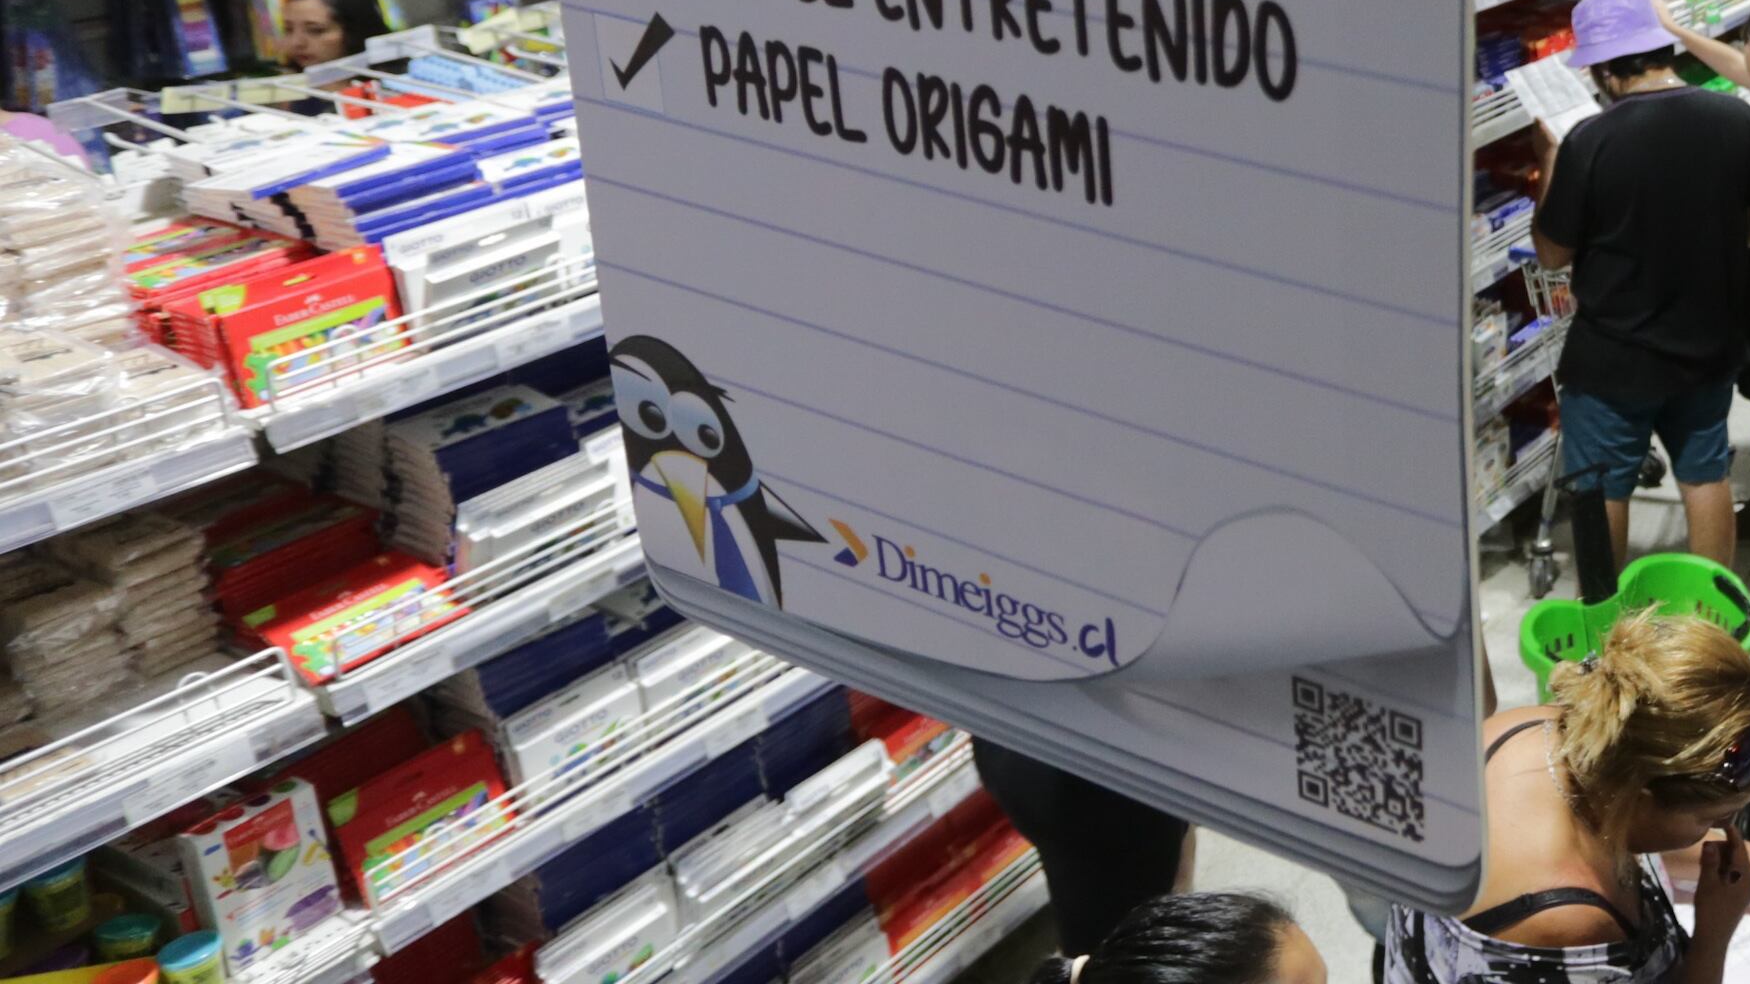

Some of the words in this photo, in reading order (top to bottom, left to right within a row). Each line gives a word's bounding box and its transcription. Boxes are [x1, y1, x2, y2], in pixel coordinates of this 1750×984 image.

[700, 26, 867, 144] PAPEL
[883, 67, 1114, 206] ORIGAMI
[469, 255, 528, 283] GIOTTO
